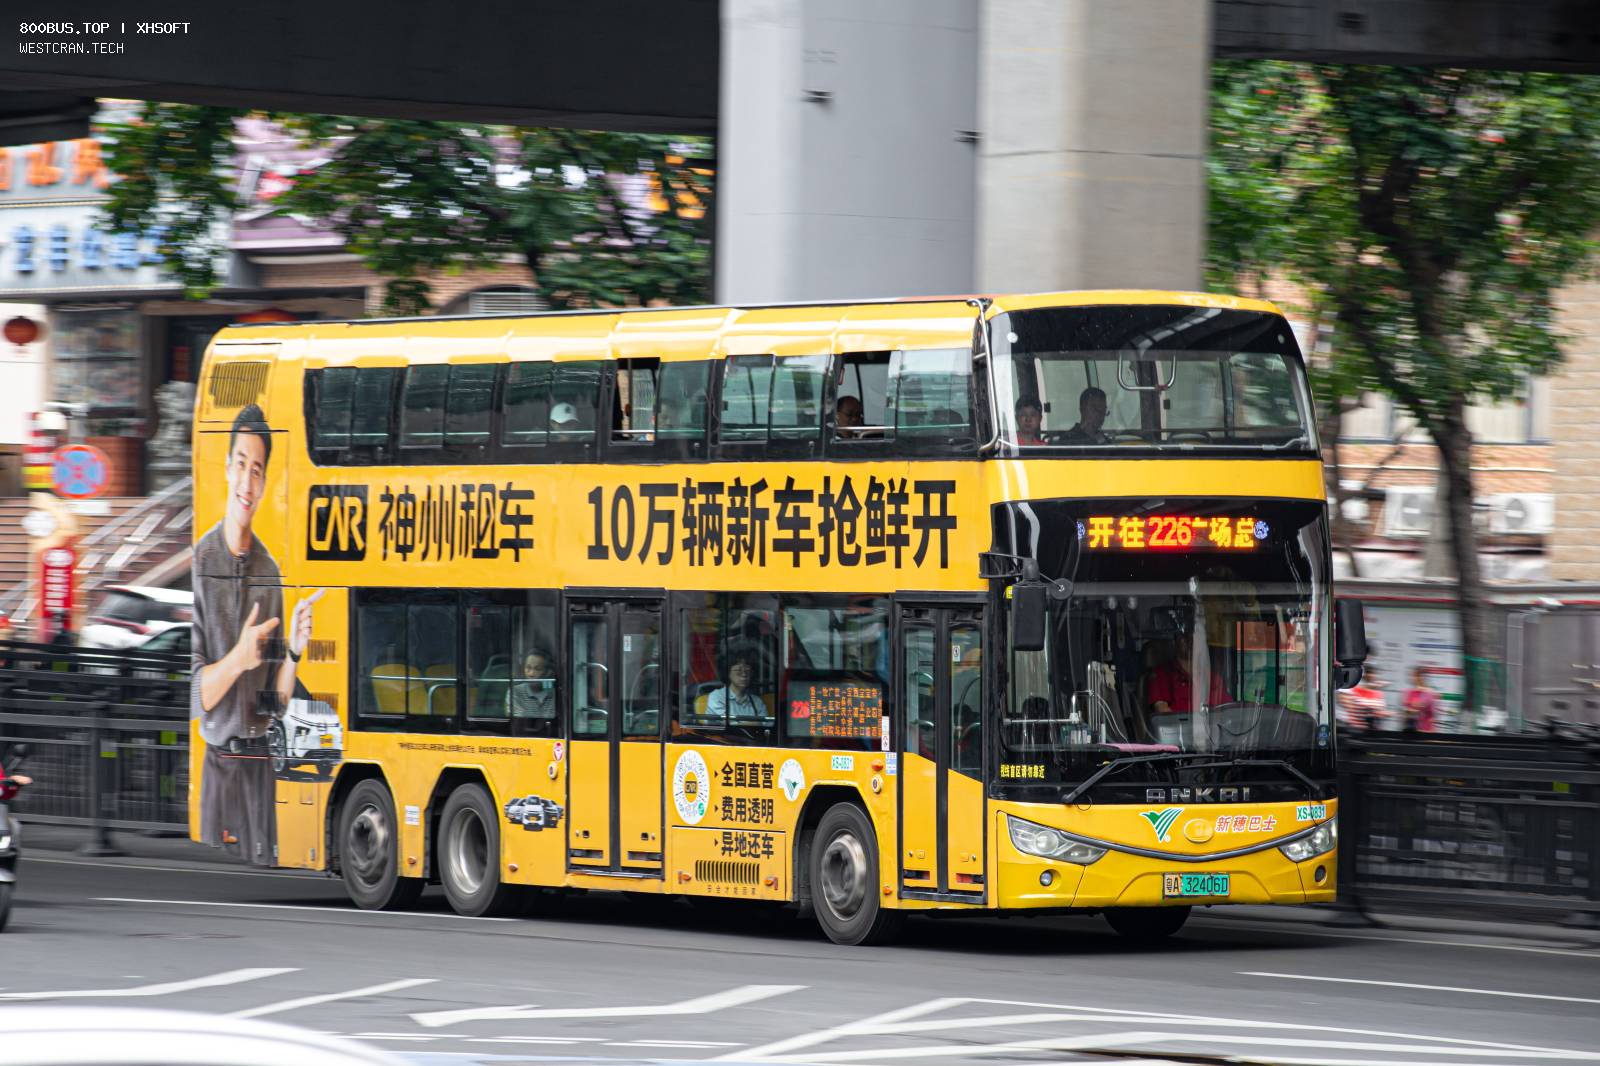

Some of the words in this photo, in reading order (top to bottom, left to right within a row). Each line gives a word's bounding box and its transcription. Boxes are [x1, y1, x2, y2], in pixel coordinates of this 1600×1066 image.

[378, 481, 535, 562] 神州租车
[587, 474, 957, 569] 10万辆新车抢鲜开
[721, 761, 774, 789] 全国直营
[1146, 787, 1250, 802] ANKAI
[721, 796, 774, 824] 费用透明
[721, 831, 774, 860] 异地还车
